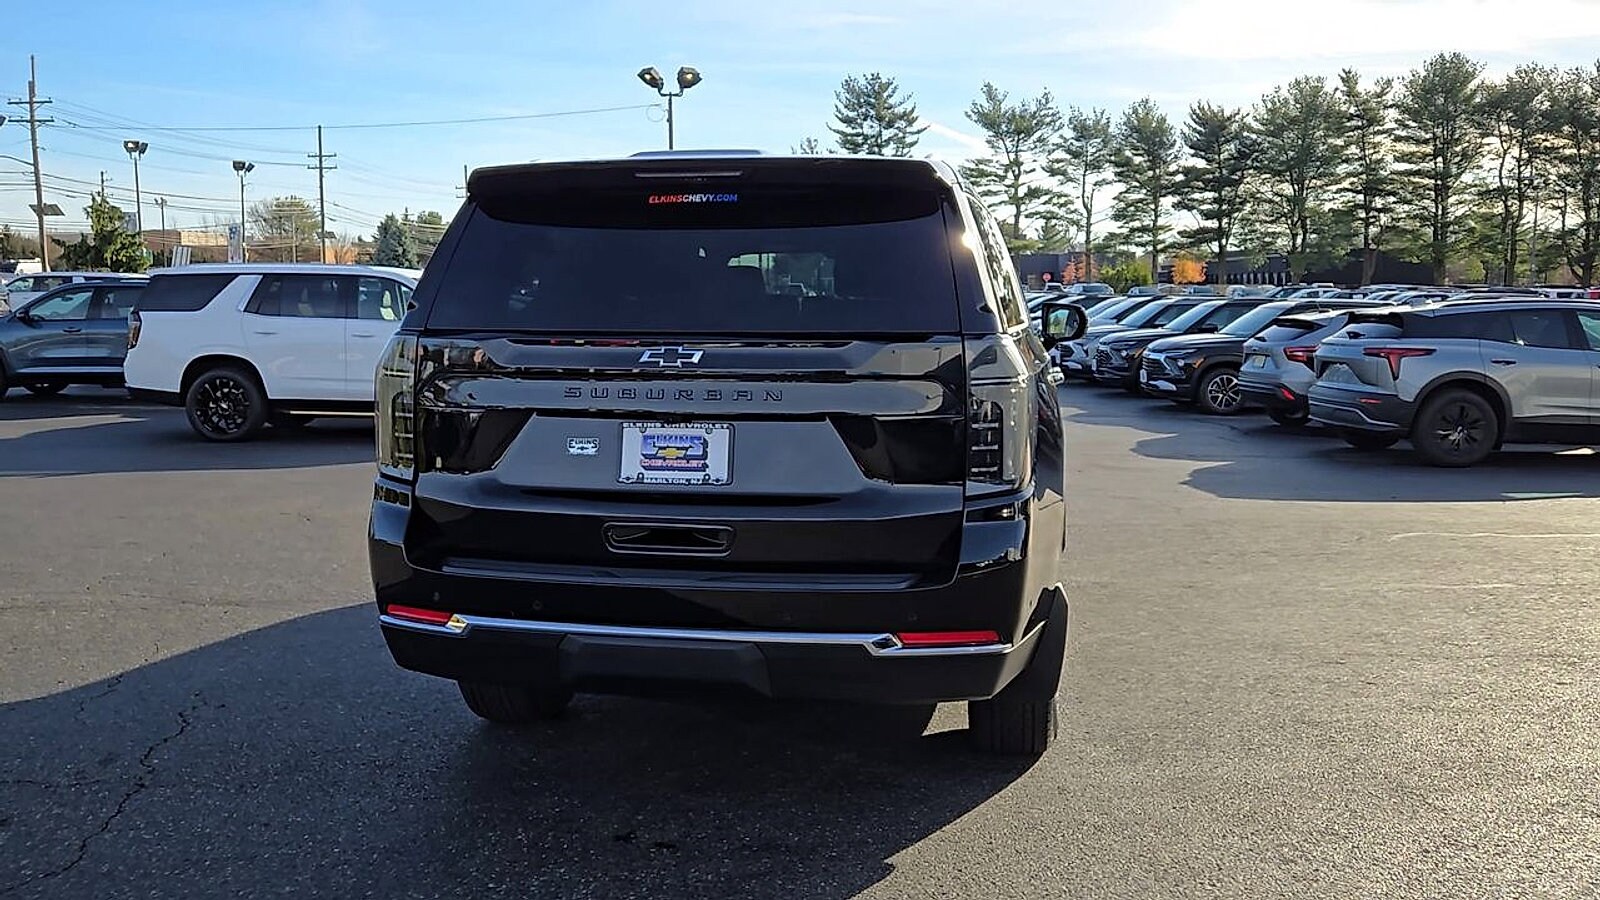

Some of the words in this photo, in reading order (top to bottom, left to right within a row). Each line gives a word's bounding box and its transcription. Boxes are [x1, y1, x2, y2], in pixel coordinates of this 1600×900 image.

[649, 194, 738, 203] ELKINSCHEVY.COM
[563, 386, 784, 402] SUBURBAN
[641, 434, 704, 456] ELKINS
